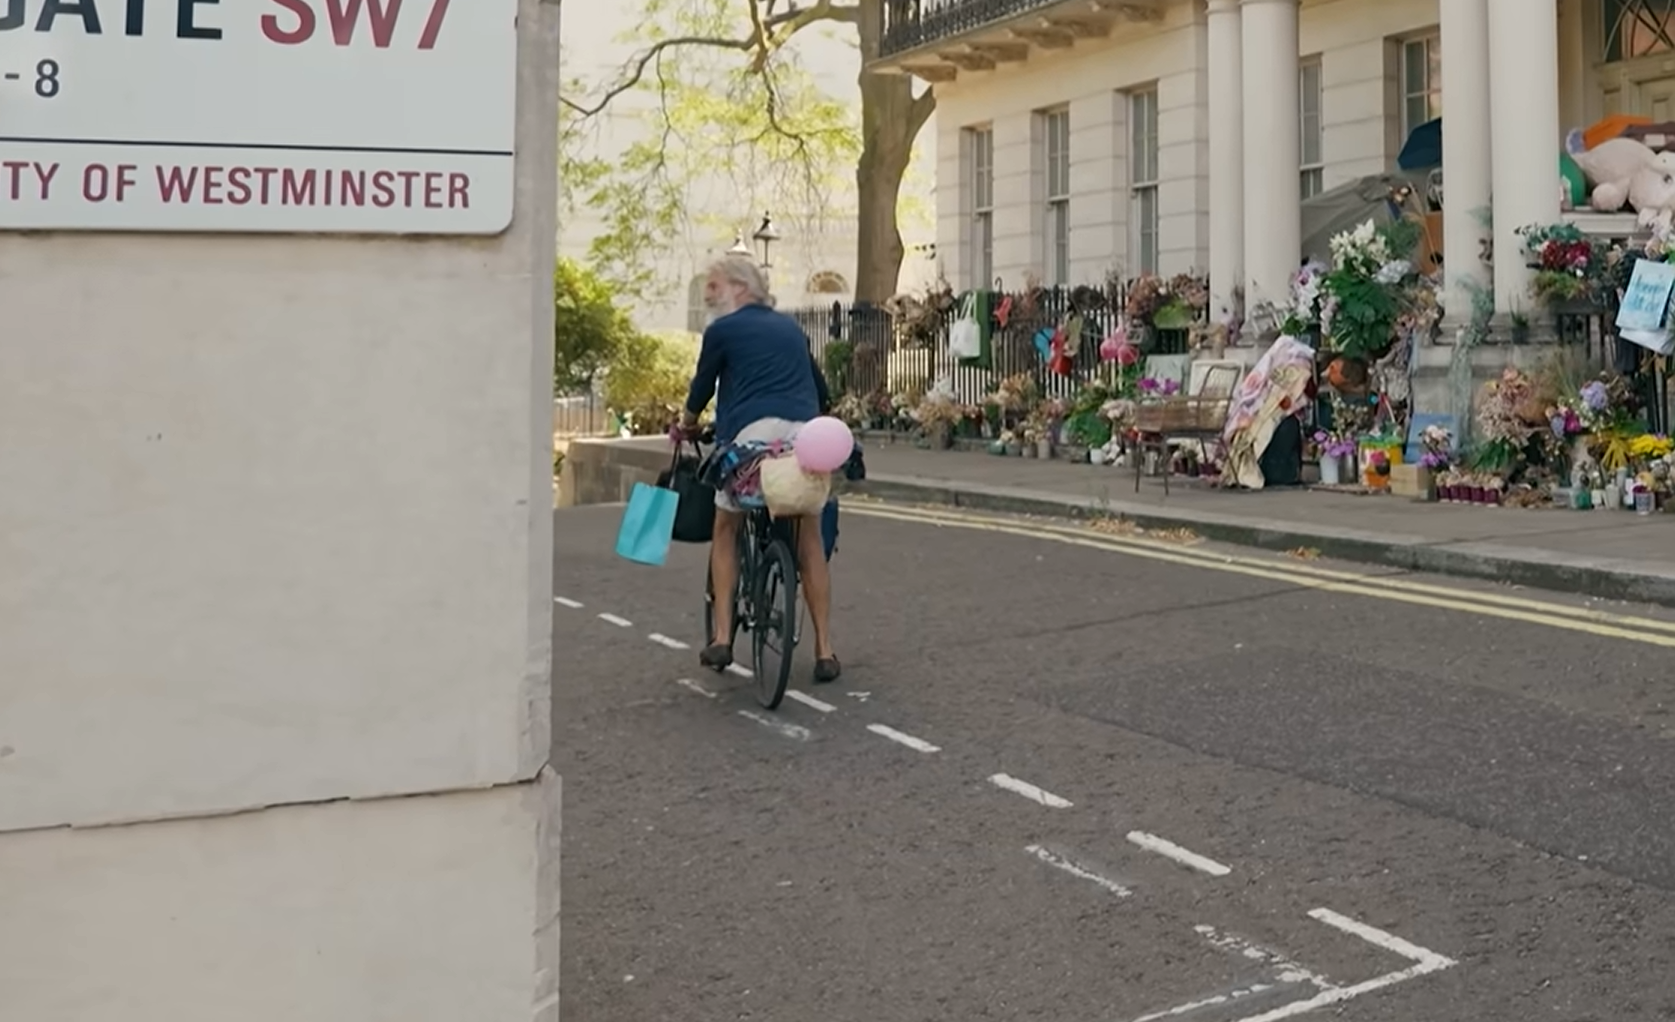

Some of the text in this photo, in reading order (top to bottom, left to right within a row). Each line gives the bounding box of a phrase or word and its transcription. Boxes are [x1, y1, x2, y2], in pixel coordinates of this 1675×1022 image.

[0, 0, 223, 40] AE
[2, 161, 471, 209] TY OF WESTMINSTER
